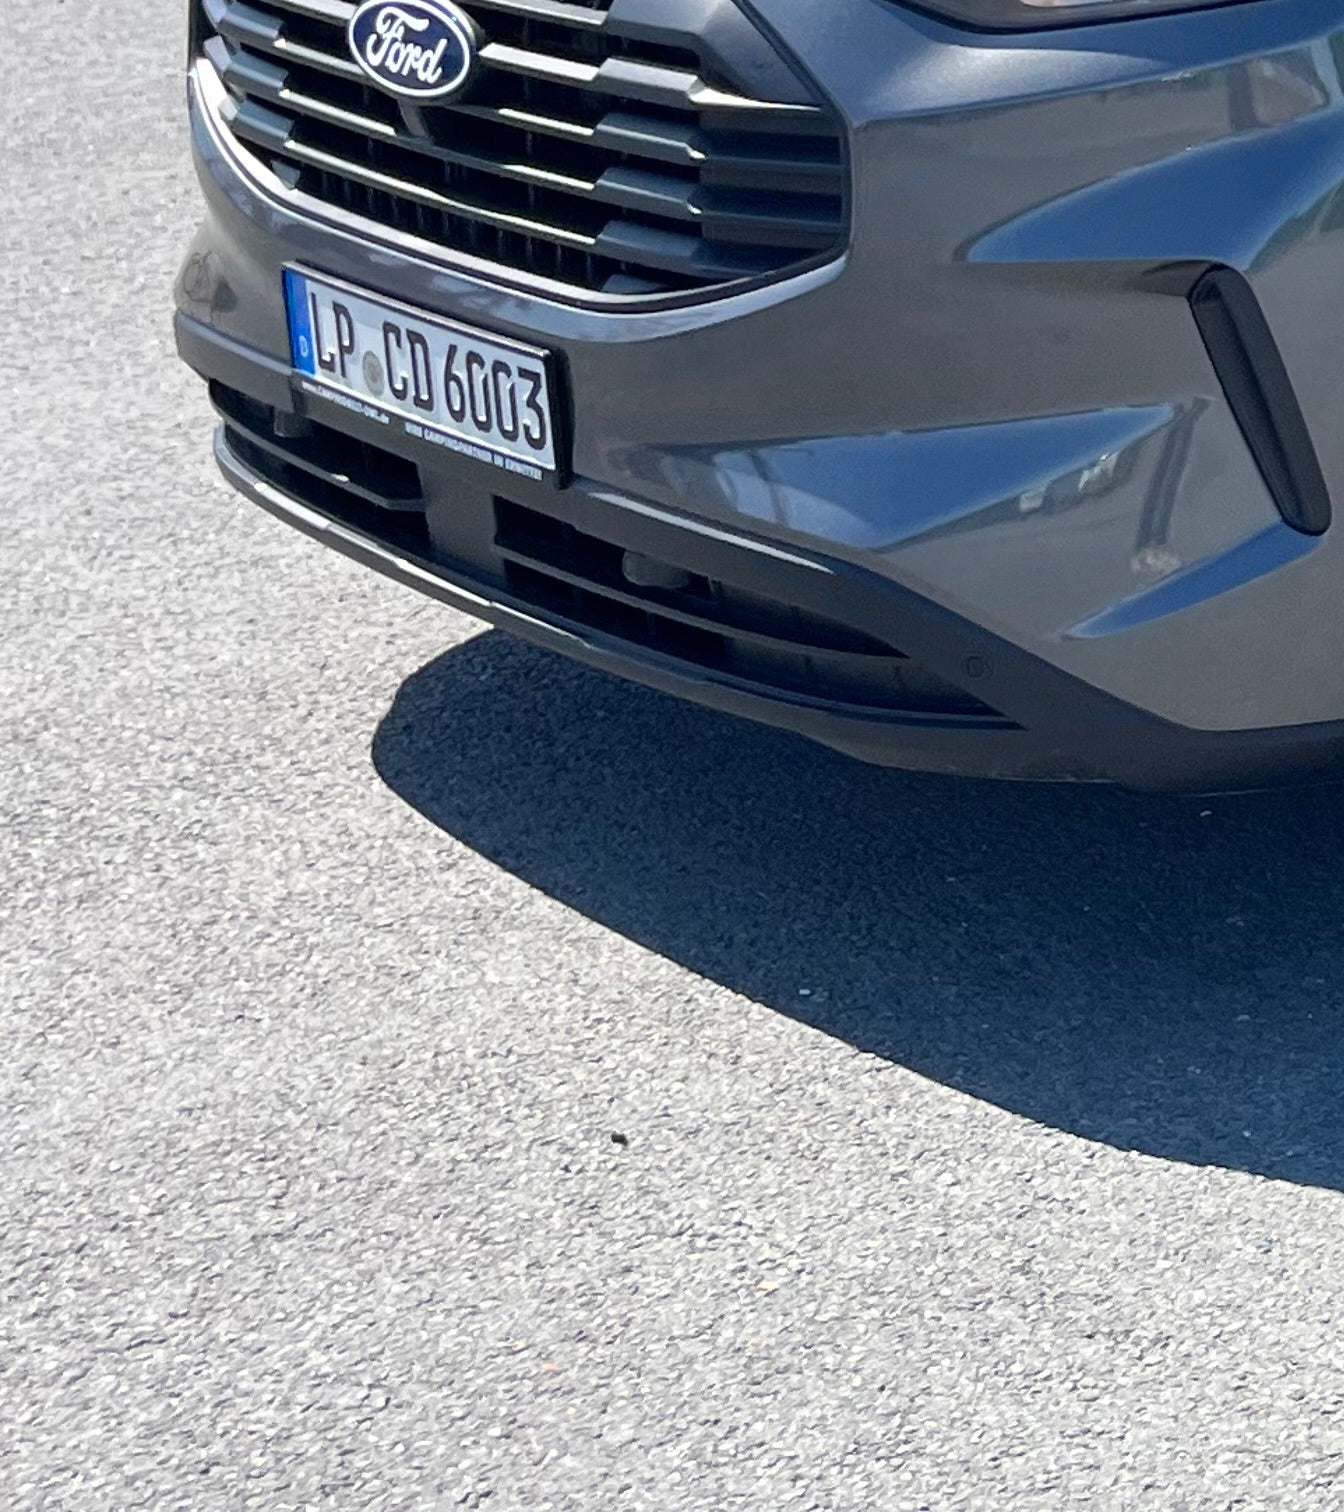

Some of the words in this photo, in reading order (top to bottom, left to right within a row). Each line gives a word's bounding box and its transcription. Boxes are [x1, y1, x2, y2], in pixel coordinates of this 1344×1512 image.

[366, 6, 448, 83] Ford
[310, 292, 355, 379] LP
[383, 320, 434, 412] CD
[443, 344, 547, 451] 6003
